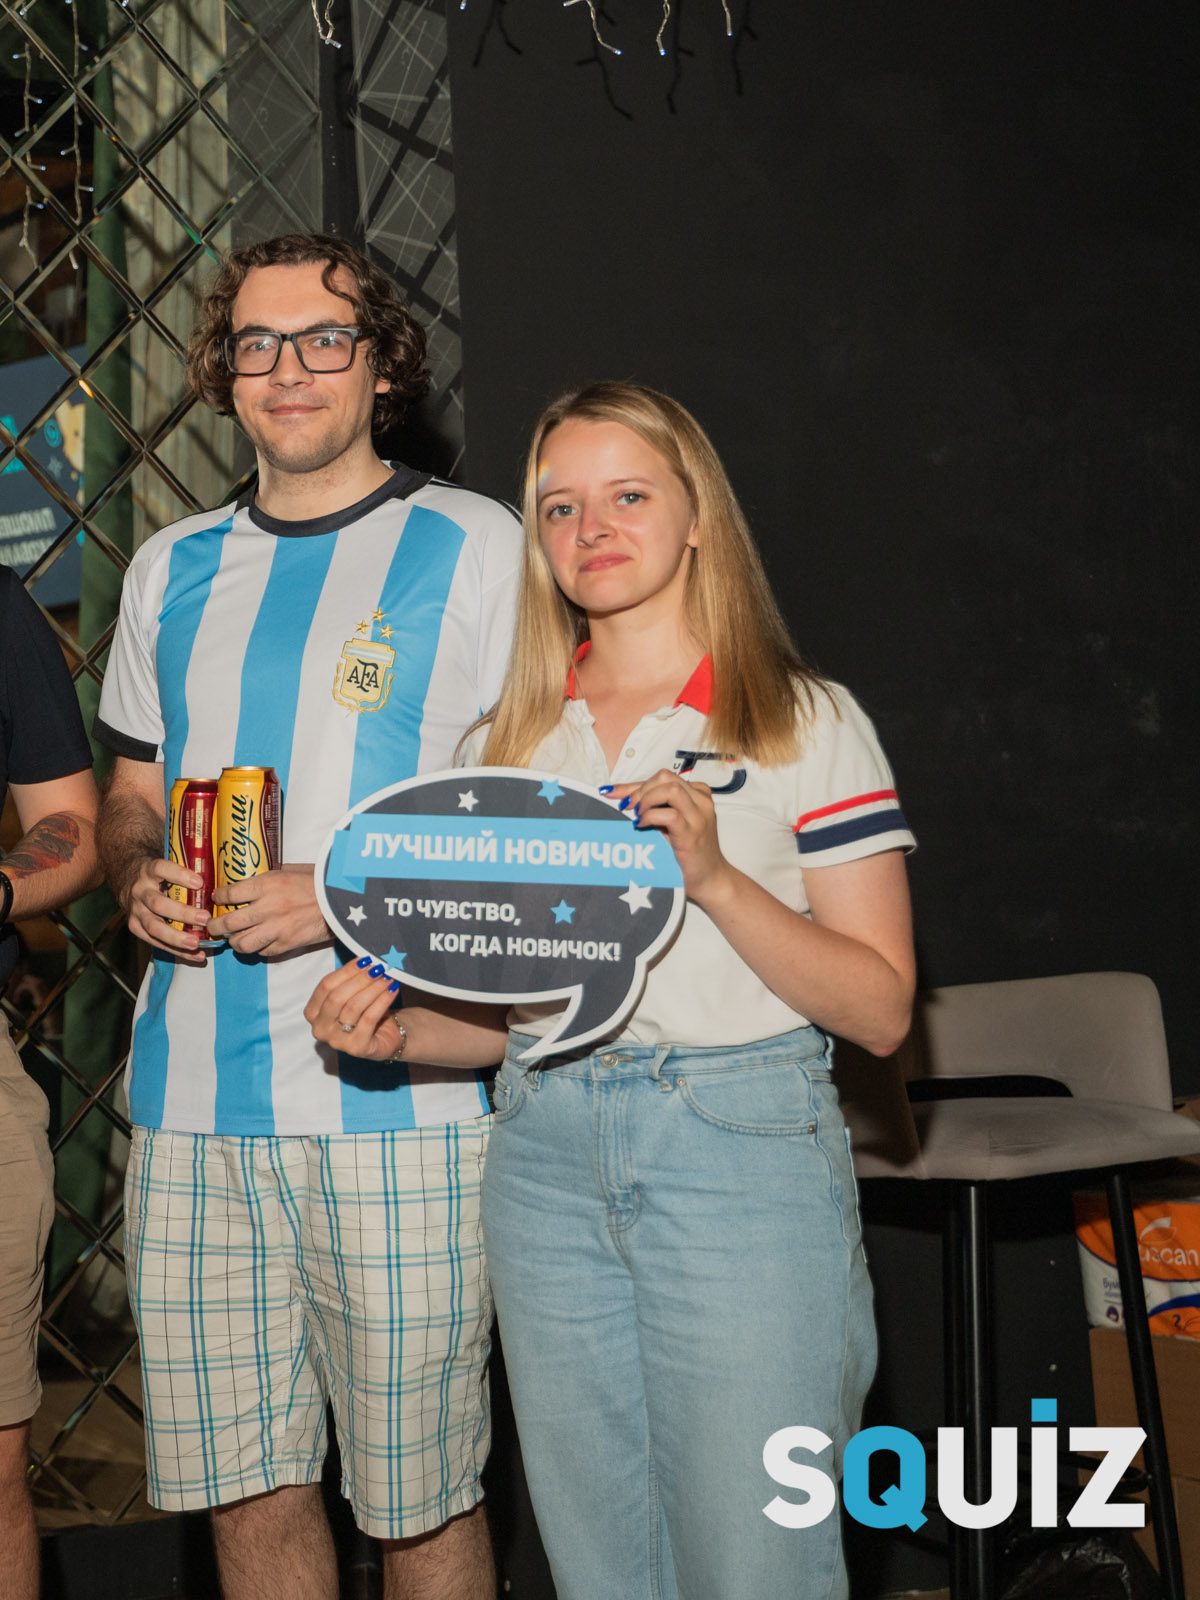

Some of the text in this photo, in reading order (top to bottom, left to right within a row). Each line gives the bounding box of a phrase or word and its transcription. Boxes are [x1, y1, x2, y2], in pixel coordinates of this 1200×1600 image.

[347, 658, 379, 692] AFA
[361, 830, 656, 870] ЛУЧШИЙ НОВИЧОК
[384, 897, 522, 926] ТО ЧУВСТВО,
[429, 933, 622, 962] КОГДА НОВИЧОК!
